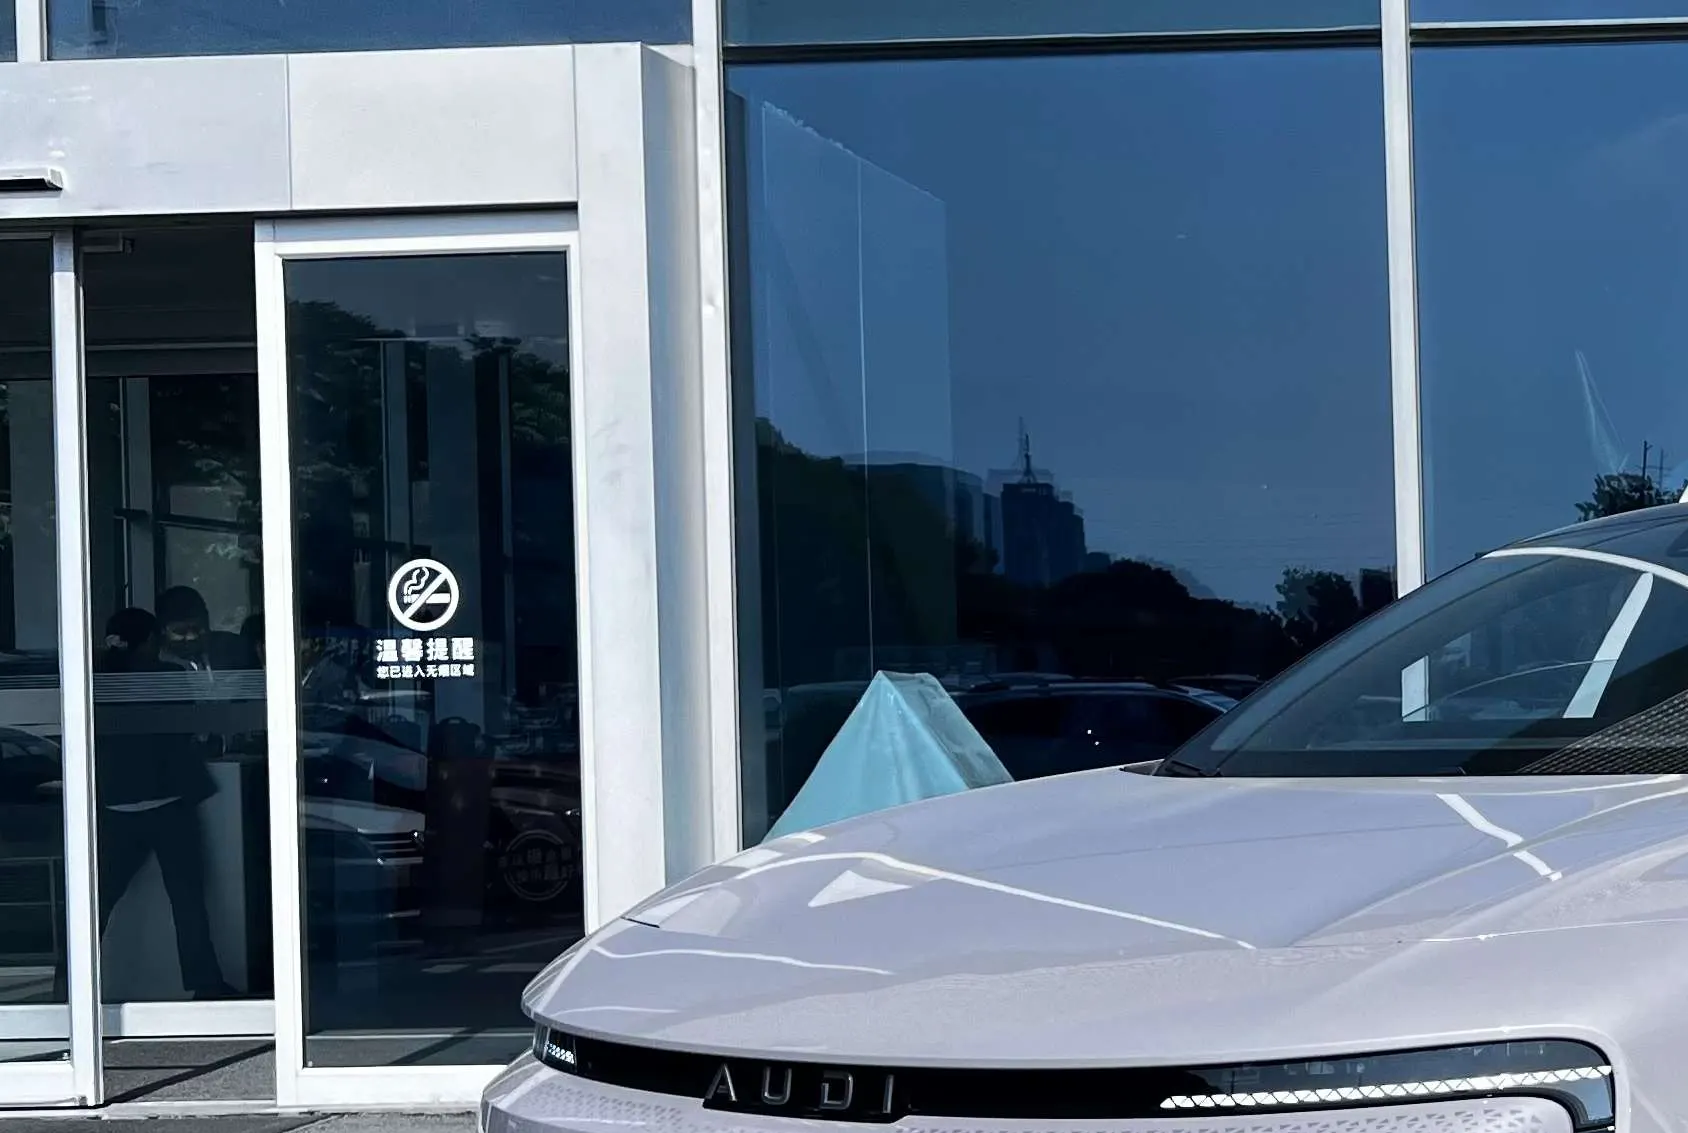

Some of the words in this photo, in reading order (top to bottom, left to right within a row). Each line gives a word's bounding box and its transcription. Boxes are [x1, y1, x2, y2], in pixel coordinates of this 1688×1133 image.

[375, 637, 475, 662] 温馨提醒
[704, 1063, 896, 1114] AUDI
